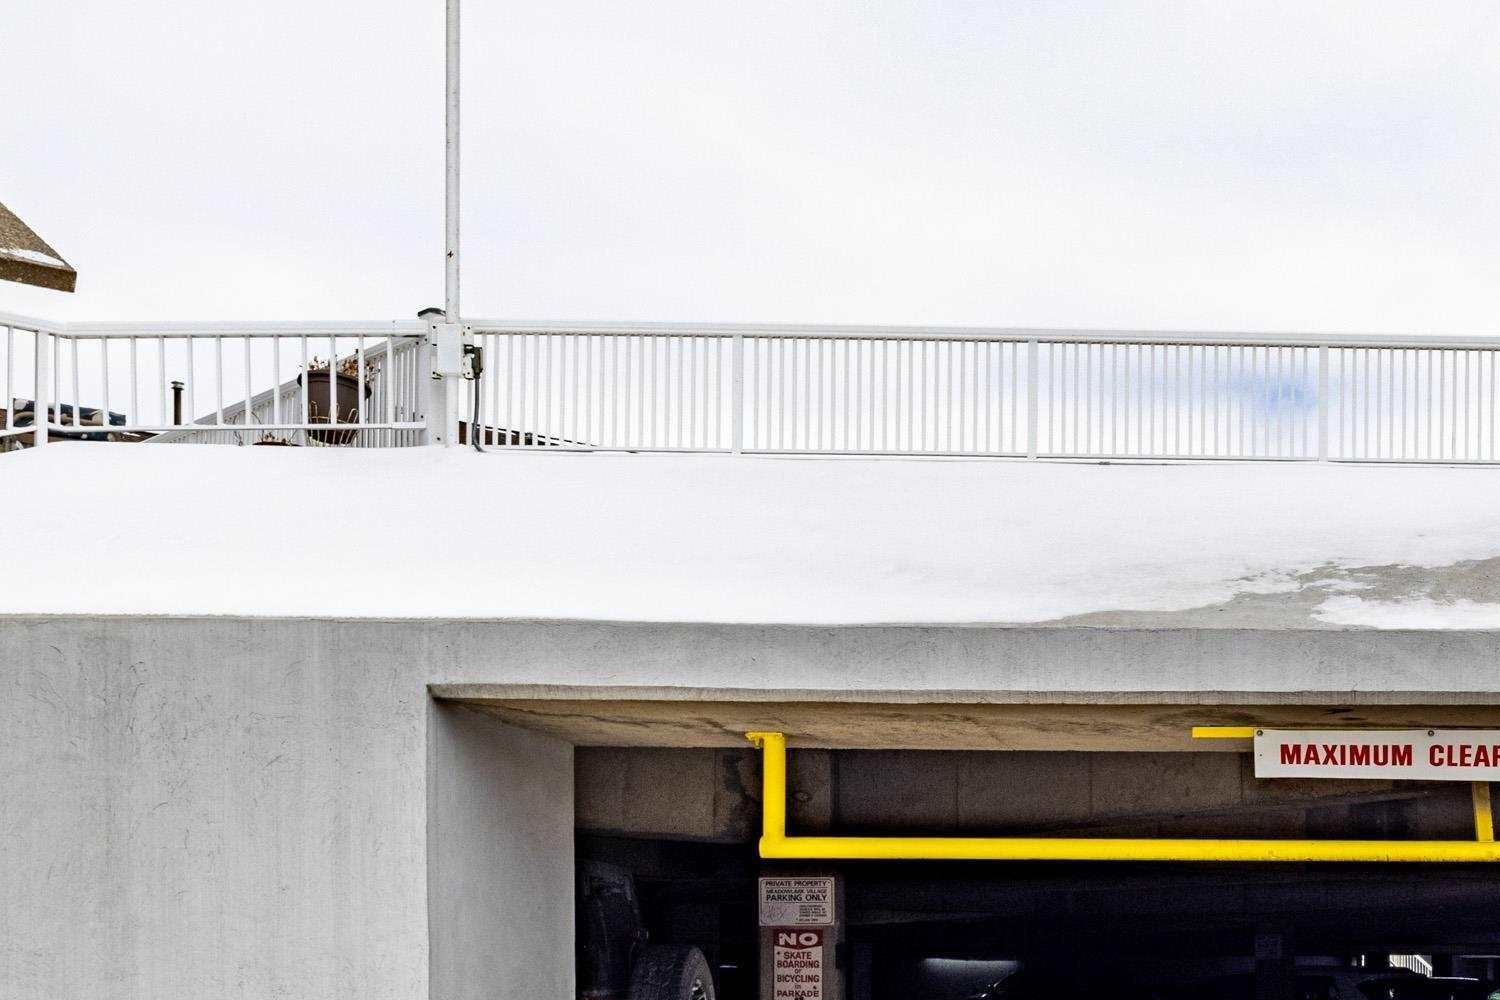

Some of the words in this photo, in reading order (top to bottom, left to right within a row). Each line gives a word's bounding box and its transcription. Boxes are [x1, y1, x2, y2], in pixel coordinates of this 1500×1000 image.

[1279, 743, 1414, 767] MAXIMUM
[766, 894, 803, 902] PARKING
[805, 894, 828, 902] ONLY
[778, 932, 819, 946] NO
[783, 951, 812, 960] SKATE
[776, 960, 820, 968] BOARDING
[776, 974, 820, 983] BICYCLING
[776, 990, 820, 998] PARKADE
